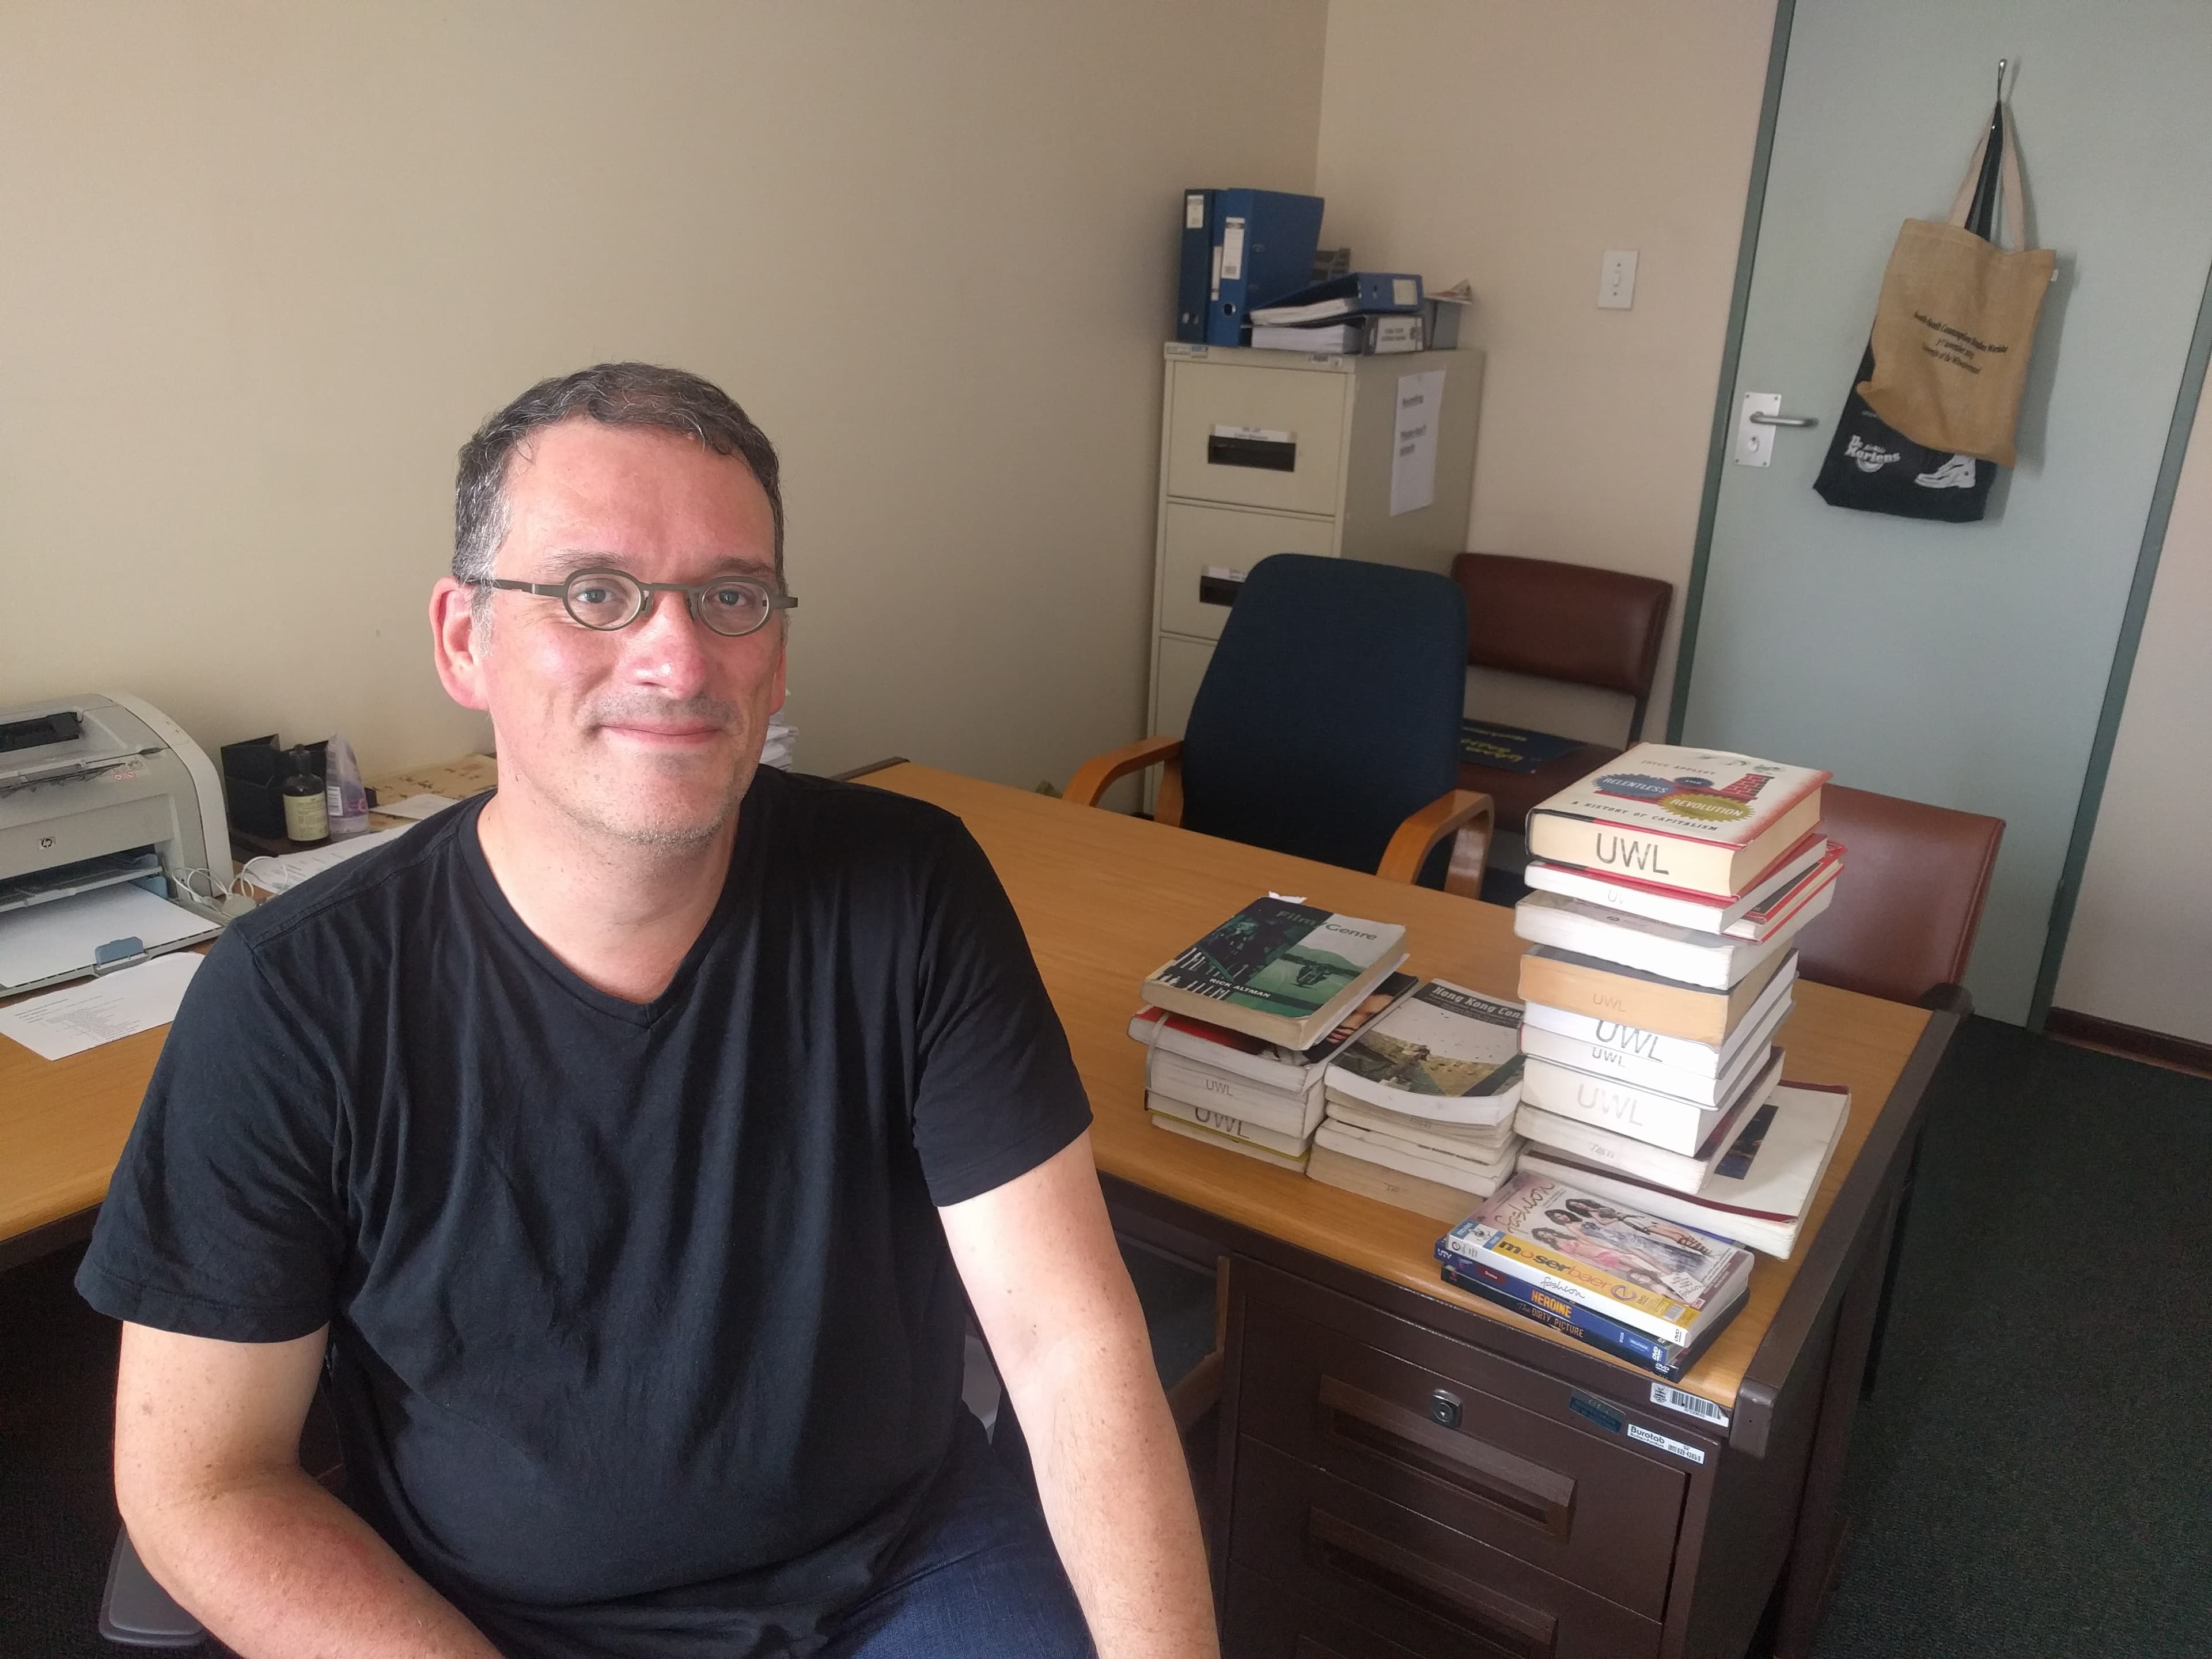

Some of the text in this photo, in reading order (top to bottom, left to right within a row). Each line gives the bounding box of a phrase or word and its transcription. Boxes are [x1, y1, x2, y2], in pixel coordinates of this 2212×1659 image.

[1603, 778, 1668, 794] RELENTLESS
[1585, 802, 1628, 814] HISTORY
[1652, 815, 1719, 831] CAPITALISM
[1670, 798, 1744, 817] REVOLUTION
[1596, 833, 1669, 875] UWL
[1209, 978, 1271, 998] RICK ALTMAN
[1431, 986, 1464, 1003] Hong
[1464, 997, 1497, 1014] Kong
[1593, 993, 1626, 1012] UWL
[1596, 1020, 1663, 1062] UWL
[1592, 1047, 1626, 1067] UWL
[1206, 1078, 1233, 1096] UWL
[1577, 1084, 1643, 1126] UWL
[1195, 1107, 1249, 1139] UWL
[1540, 1277, 1585, 1298] fashion
[1531, 1290, 1572, 1318] HEROINE
[1517, 1302, 1584, 1338] The DIRTY PICTURE
[1656, 1362, 1670, 1371] DVD
[1631, 1426, 1665, 1444] Burotab
